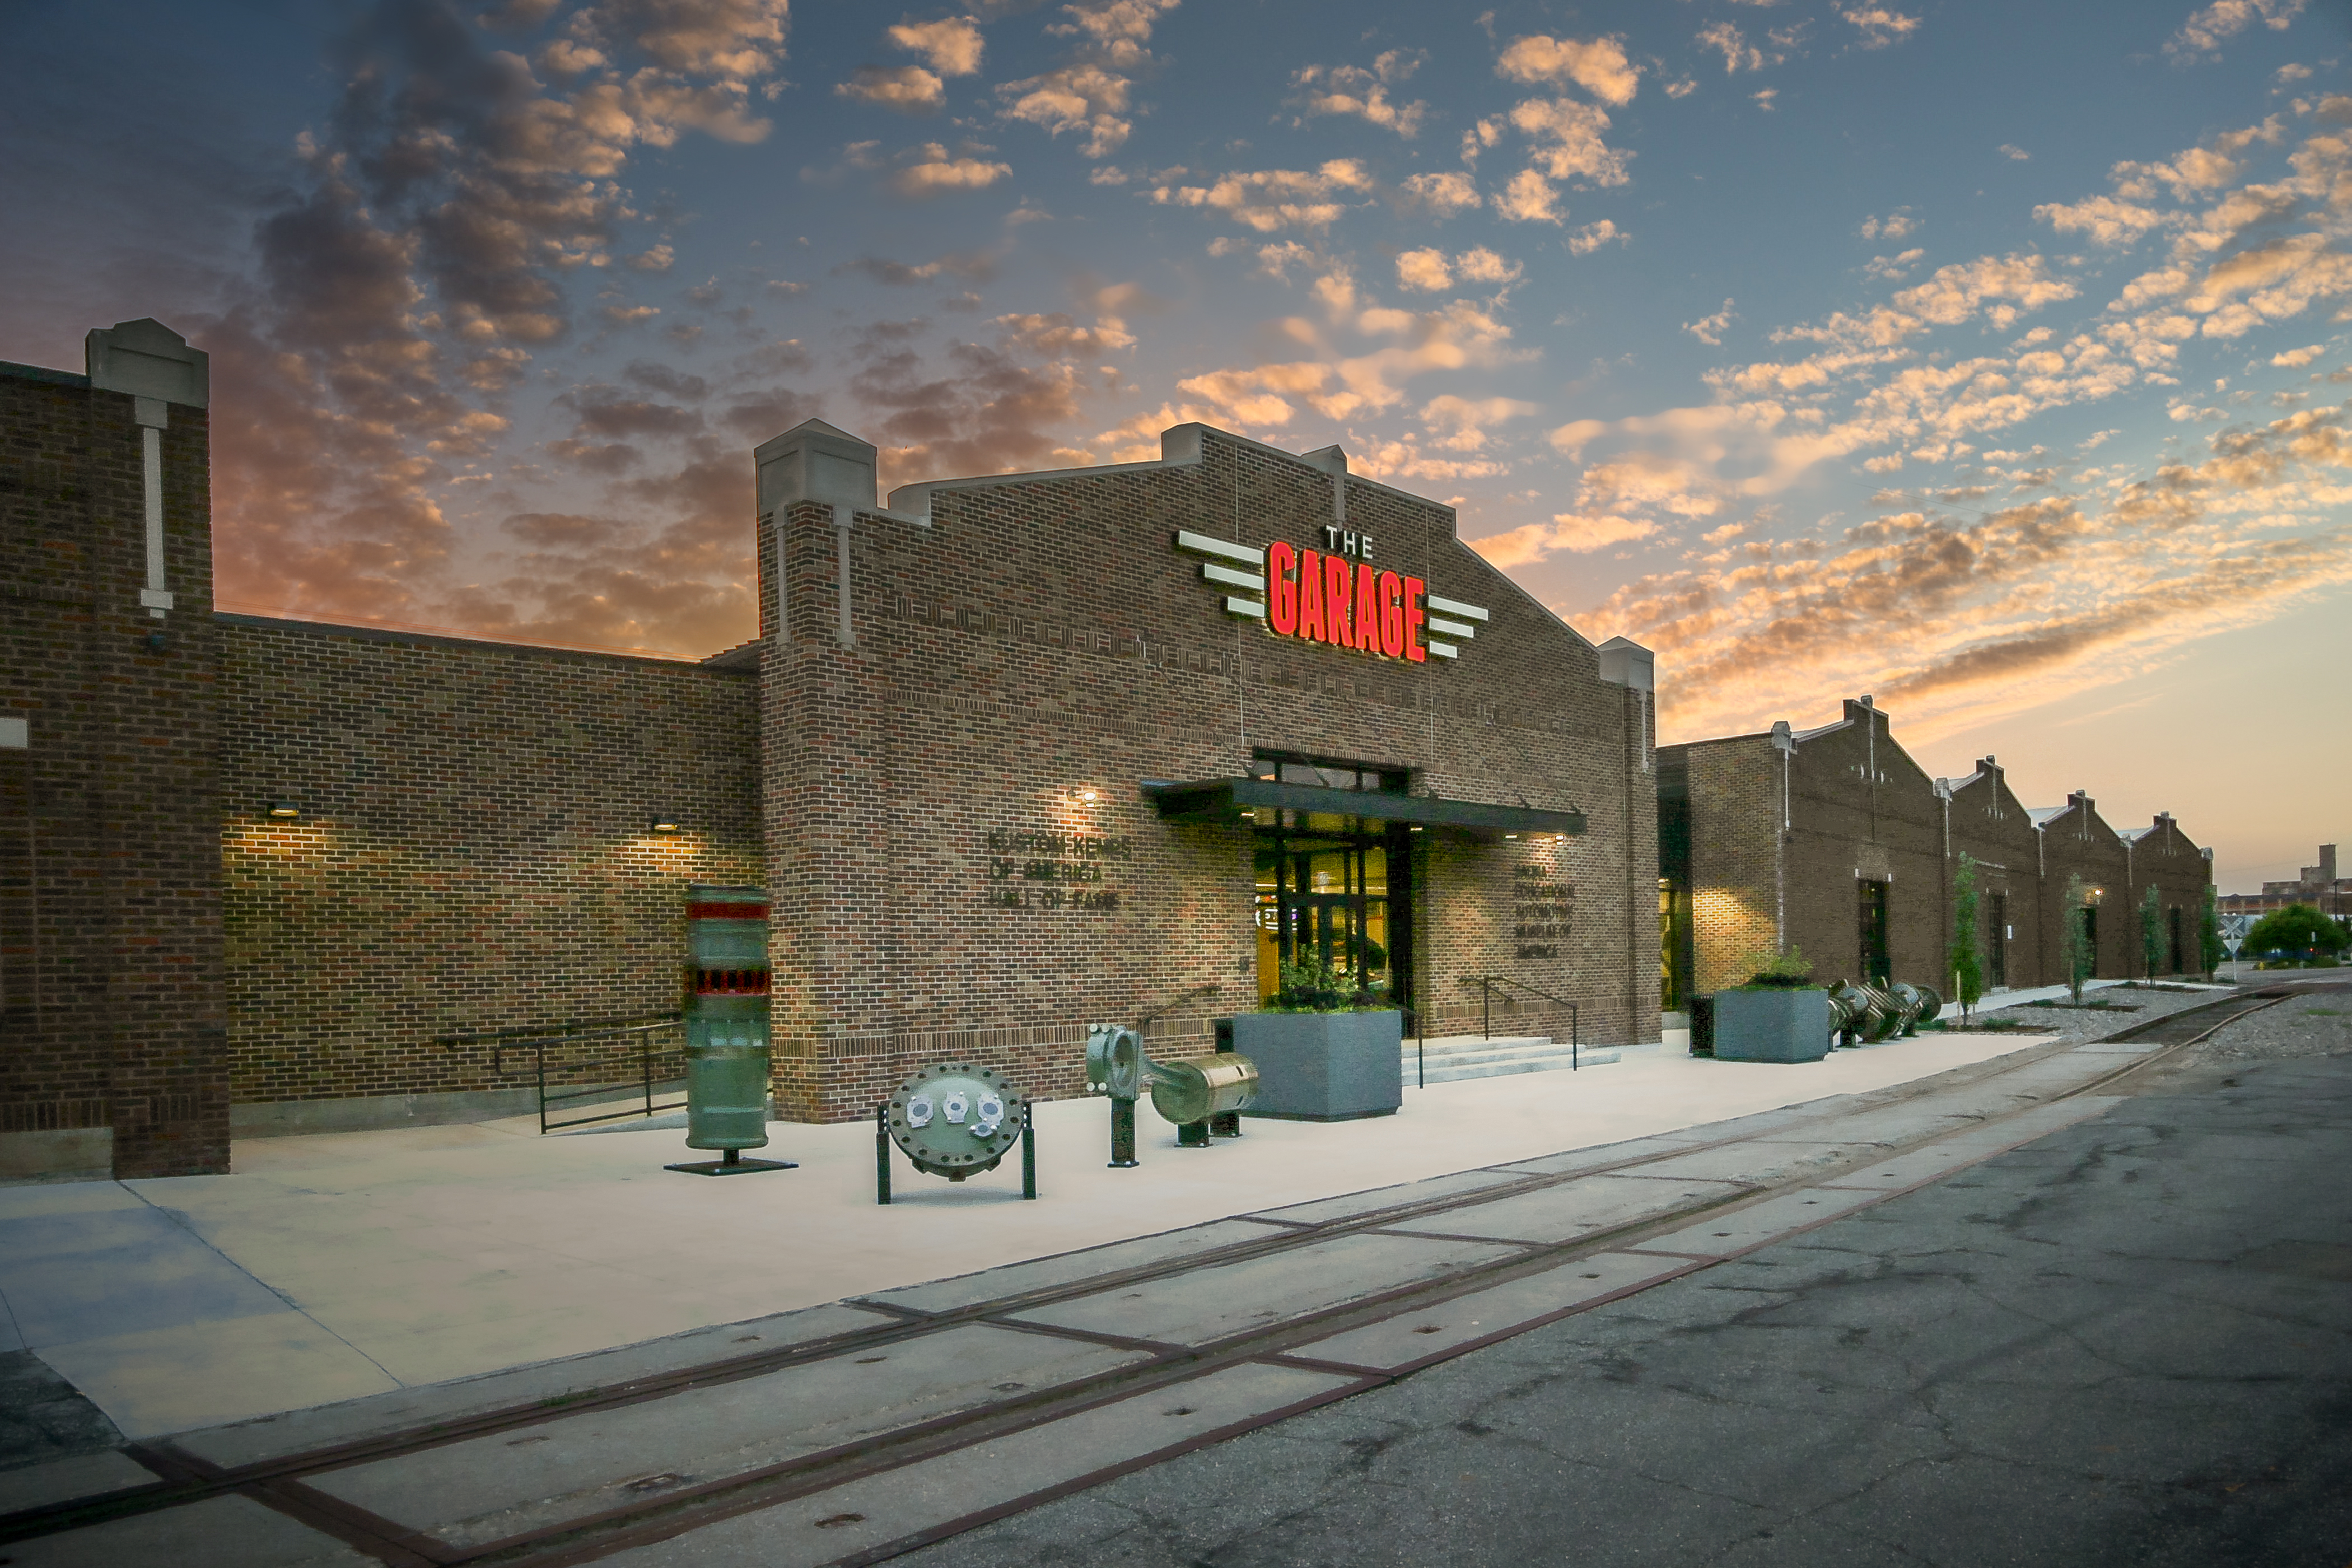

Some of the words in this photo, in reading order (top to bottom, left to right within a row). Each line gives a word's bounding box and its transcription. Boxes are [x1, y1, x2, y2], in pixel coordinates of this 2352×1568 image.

[1326, 525, 1373, 559] THE
[1270, 542, 1425, 662] GARAGE
[990, 858, 1015, 879] OF
[1024, 861, 1102, 883] AMERICA
